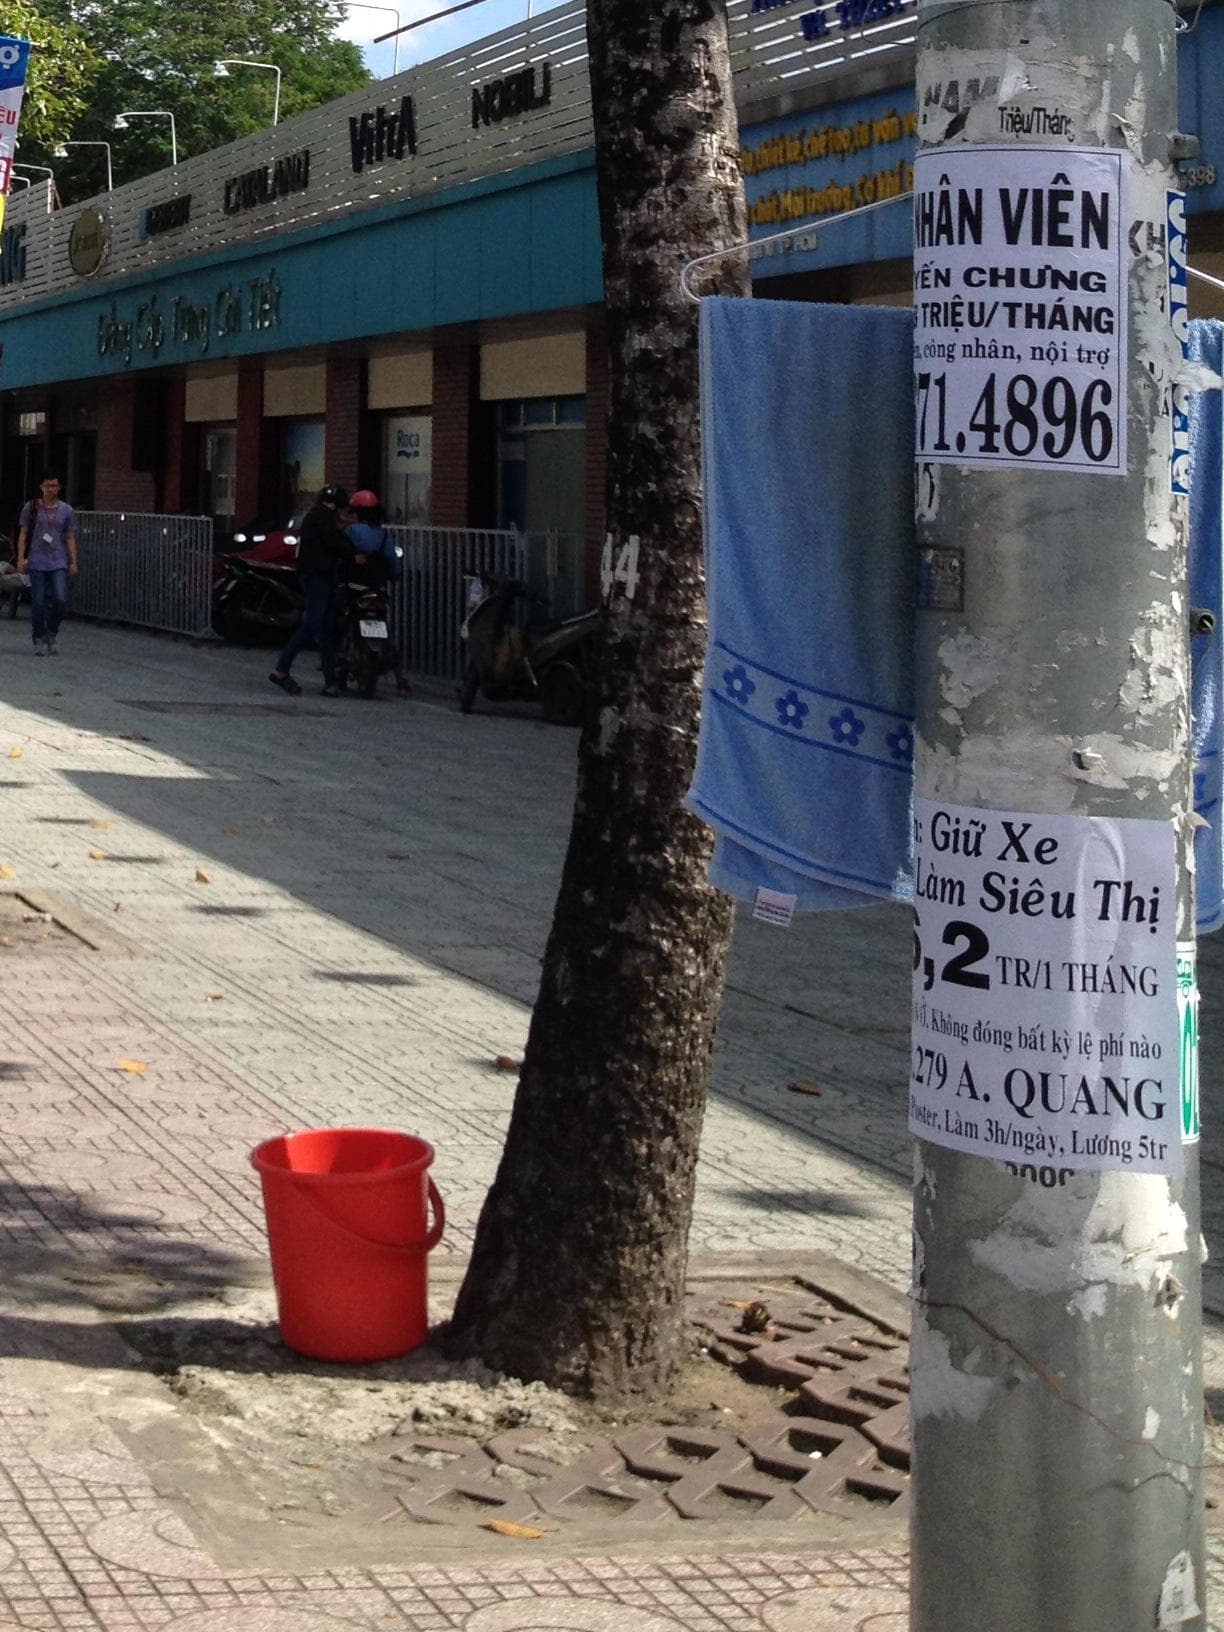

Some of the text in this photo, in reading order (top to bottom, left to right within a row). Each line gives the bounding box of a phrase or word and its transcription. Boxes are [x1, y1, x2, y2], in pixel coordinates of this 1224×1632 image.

[999, 172, 1109, 250] VIÊN
[962, 265, 1107, 293] CHƯNG
[922, 294, 1114, 334] TRIỆU/THÁNG
[924, 339, 956, 363] công
[961, 337, 1022, 362] nhân,
[1029, 341, 1068, 366] nội
[1077, 347, 1110, 370] trợ
[931, 811, 987, 858] Giữ
[997, 821, 1059, 865] Xe
[916, 857, 1160, 934] Làm Siêu Thị
[996, 955, 1053, 991] TR/1
[1062, 955, 1159, 998] THÁNG
[931, 1008, 968, 1046] Không
[972, 1019, 1013, 1053] đóng
[1018, 1023, 1046, 1052] bất
[1052, 1029, 1073, 1060] kỳ
[1078, 1032, 1093, 1064] lệ
[1099, 1031, 1124, 1063] phí
[1130, 1034, 1162, 1060] nào
[956, 1059, 991, 1103] A.
[1003, 1068, 1167, 1121] QUANG
[945, 1108, 979, 1139] Làm
[983, 1118, 1065, 1158] 3h/ngày,
[1071, 1129, 1132, 1165] Lương
[1138, 1134, 1168, 1160] 5tr
